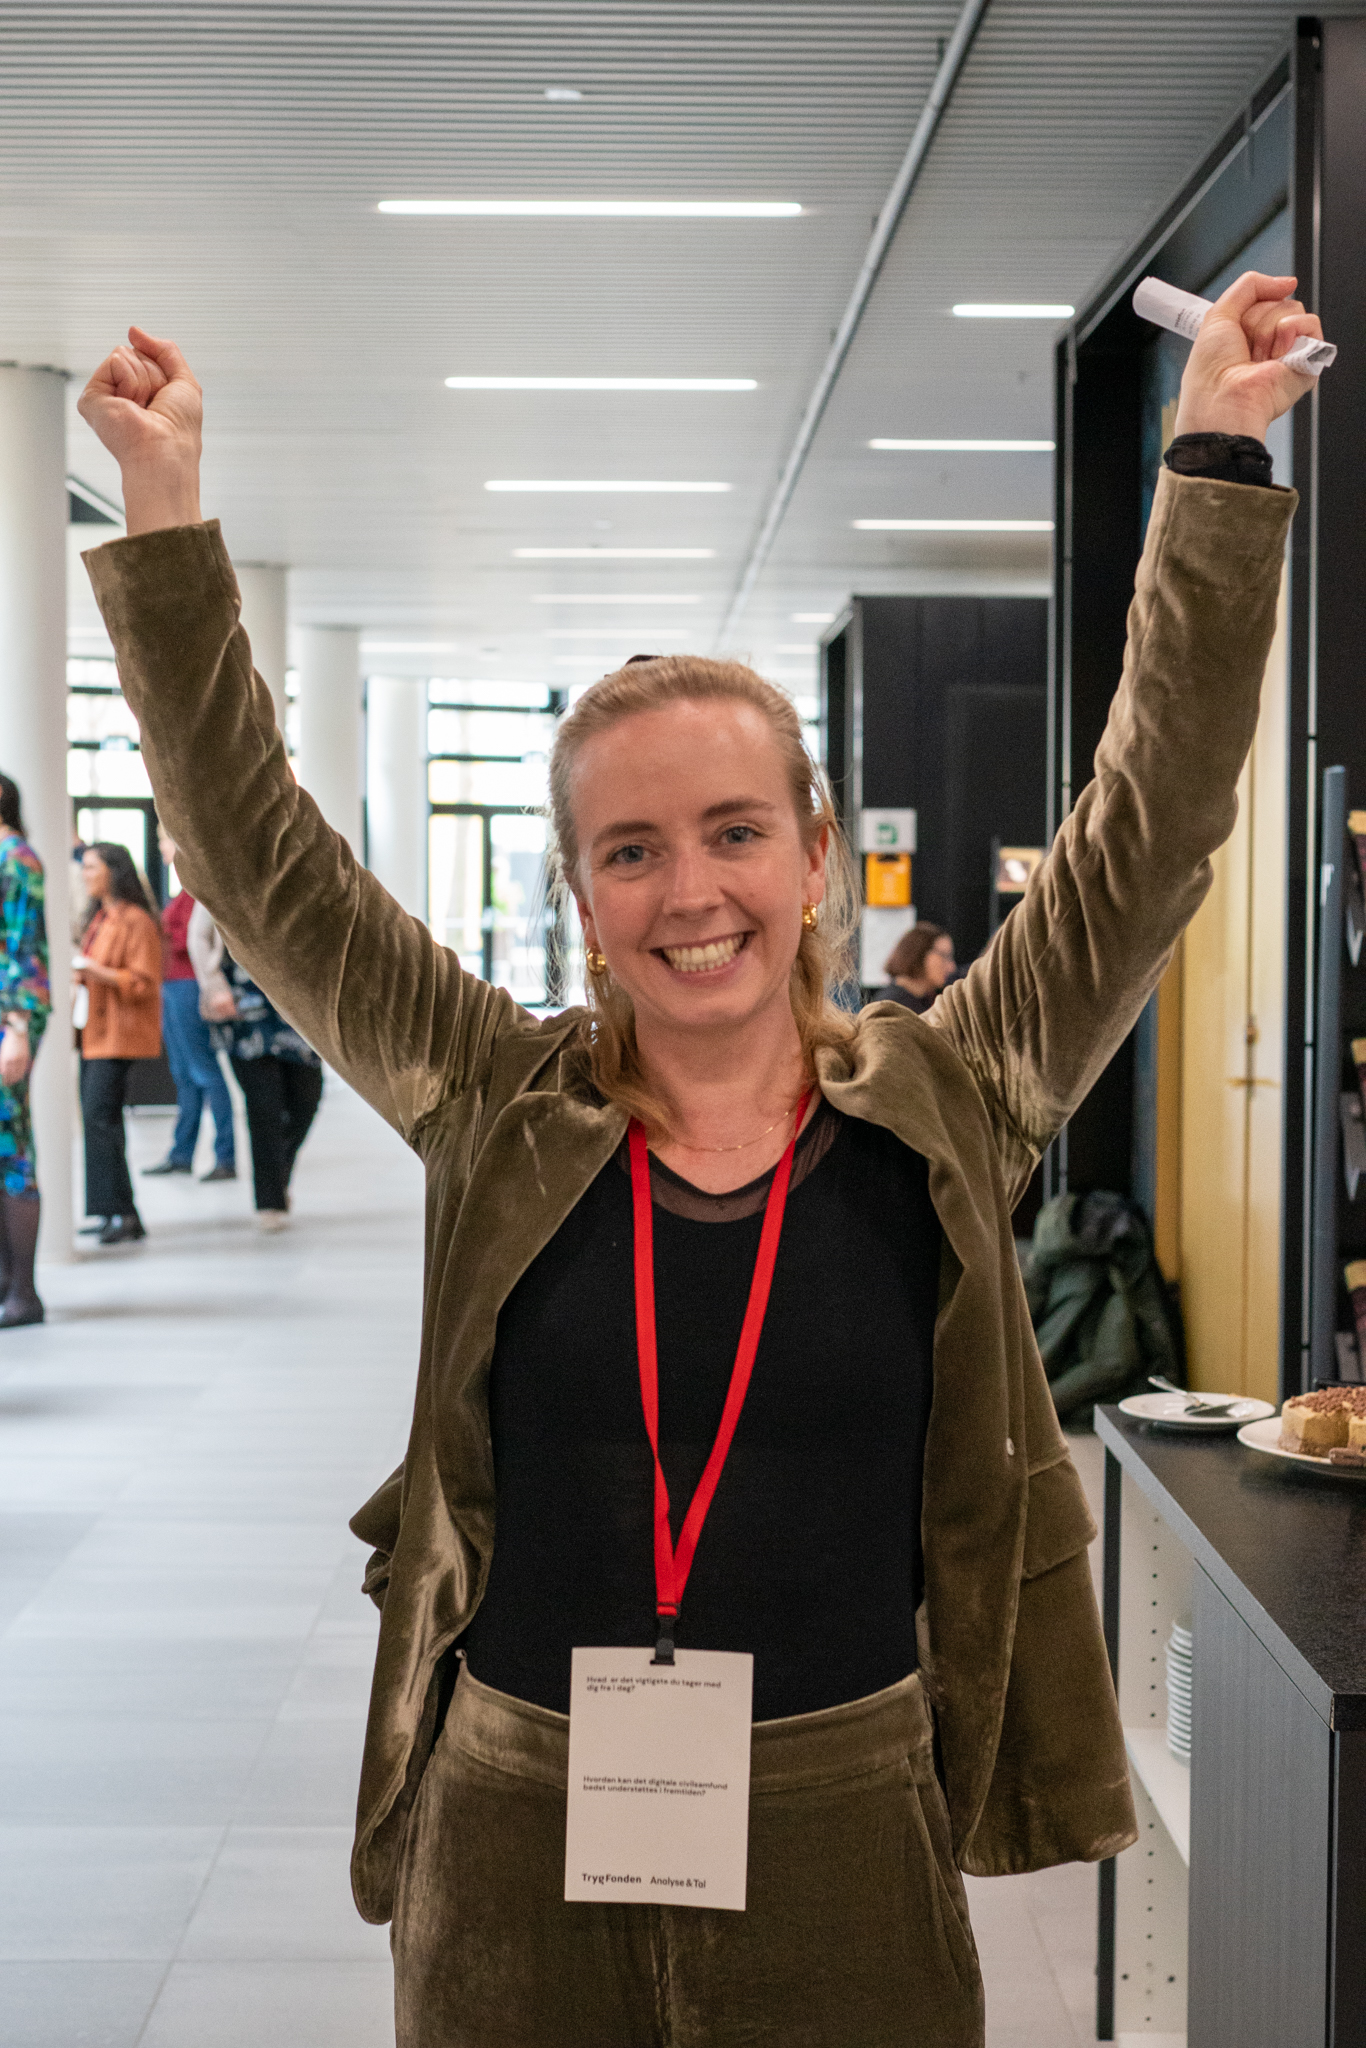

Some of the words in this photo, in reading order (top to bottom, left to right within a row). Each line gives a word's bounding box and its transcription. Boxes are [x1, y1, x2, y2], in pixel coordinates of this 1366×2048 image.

[587, 1684, 598, 1692] dig
[682, 1679, 702, 1688] tager
[648, 1778, 677, 1787] digitale
[679, 1780, 728, 1790] civilsamfund
[664, 1787, 706, 1796] fremtiden?
[582, 1873, 642, 1885] TrygFonden
[650, 1876, 684, 1888] Analyse
[686, 1878, 692, 1887] &
[694, 1879, 706, 1889] Tal
